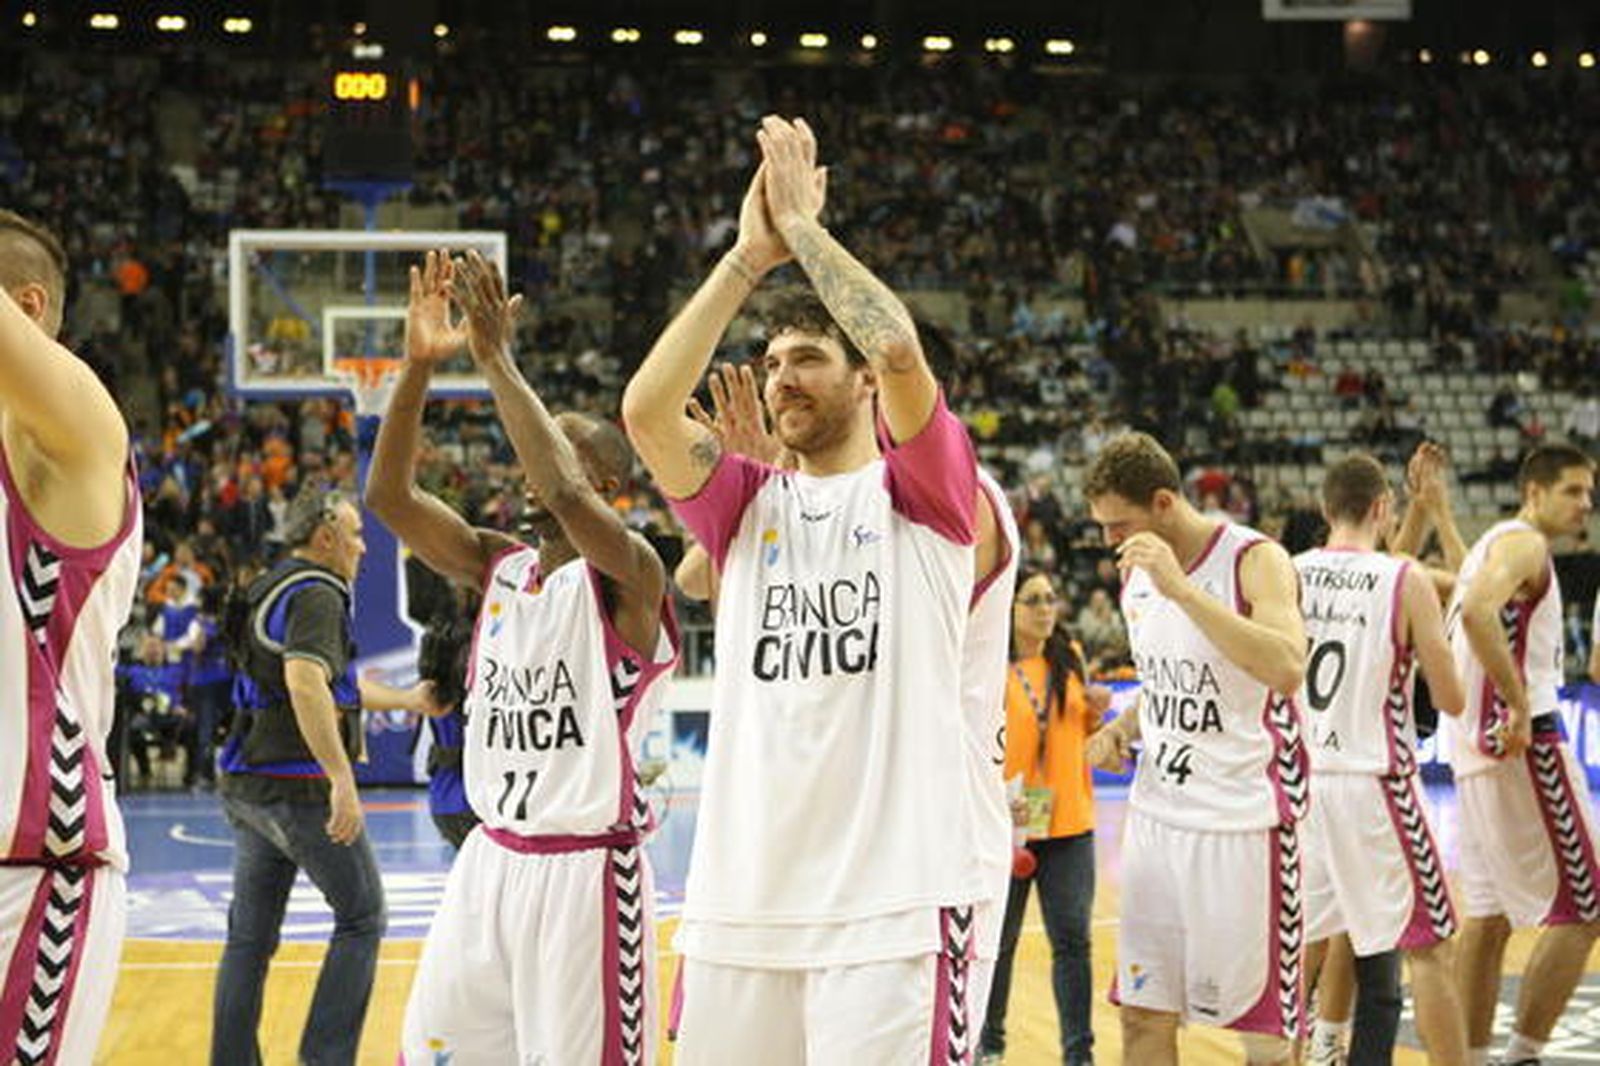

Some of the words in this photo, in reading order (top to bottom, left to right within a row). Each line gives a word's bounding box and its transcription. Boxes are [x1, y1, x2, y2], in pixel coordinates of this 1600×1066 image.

[762, 570, 881, 630] BANCA
[1137, 655, 1221, 695] ANCA
[1306, 636, 1346, 712] 0
[486, 705, 585, 752] ÍVICA
[497, 770, 538, 821] 11
